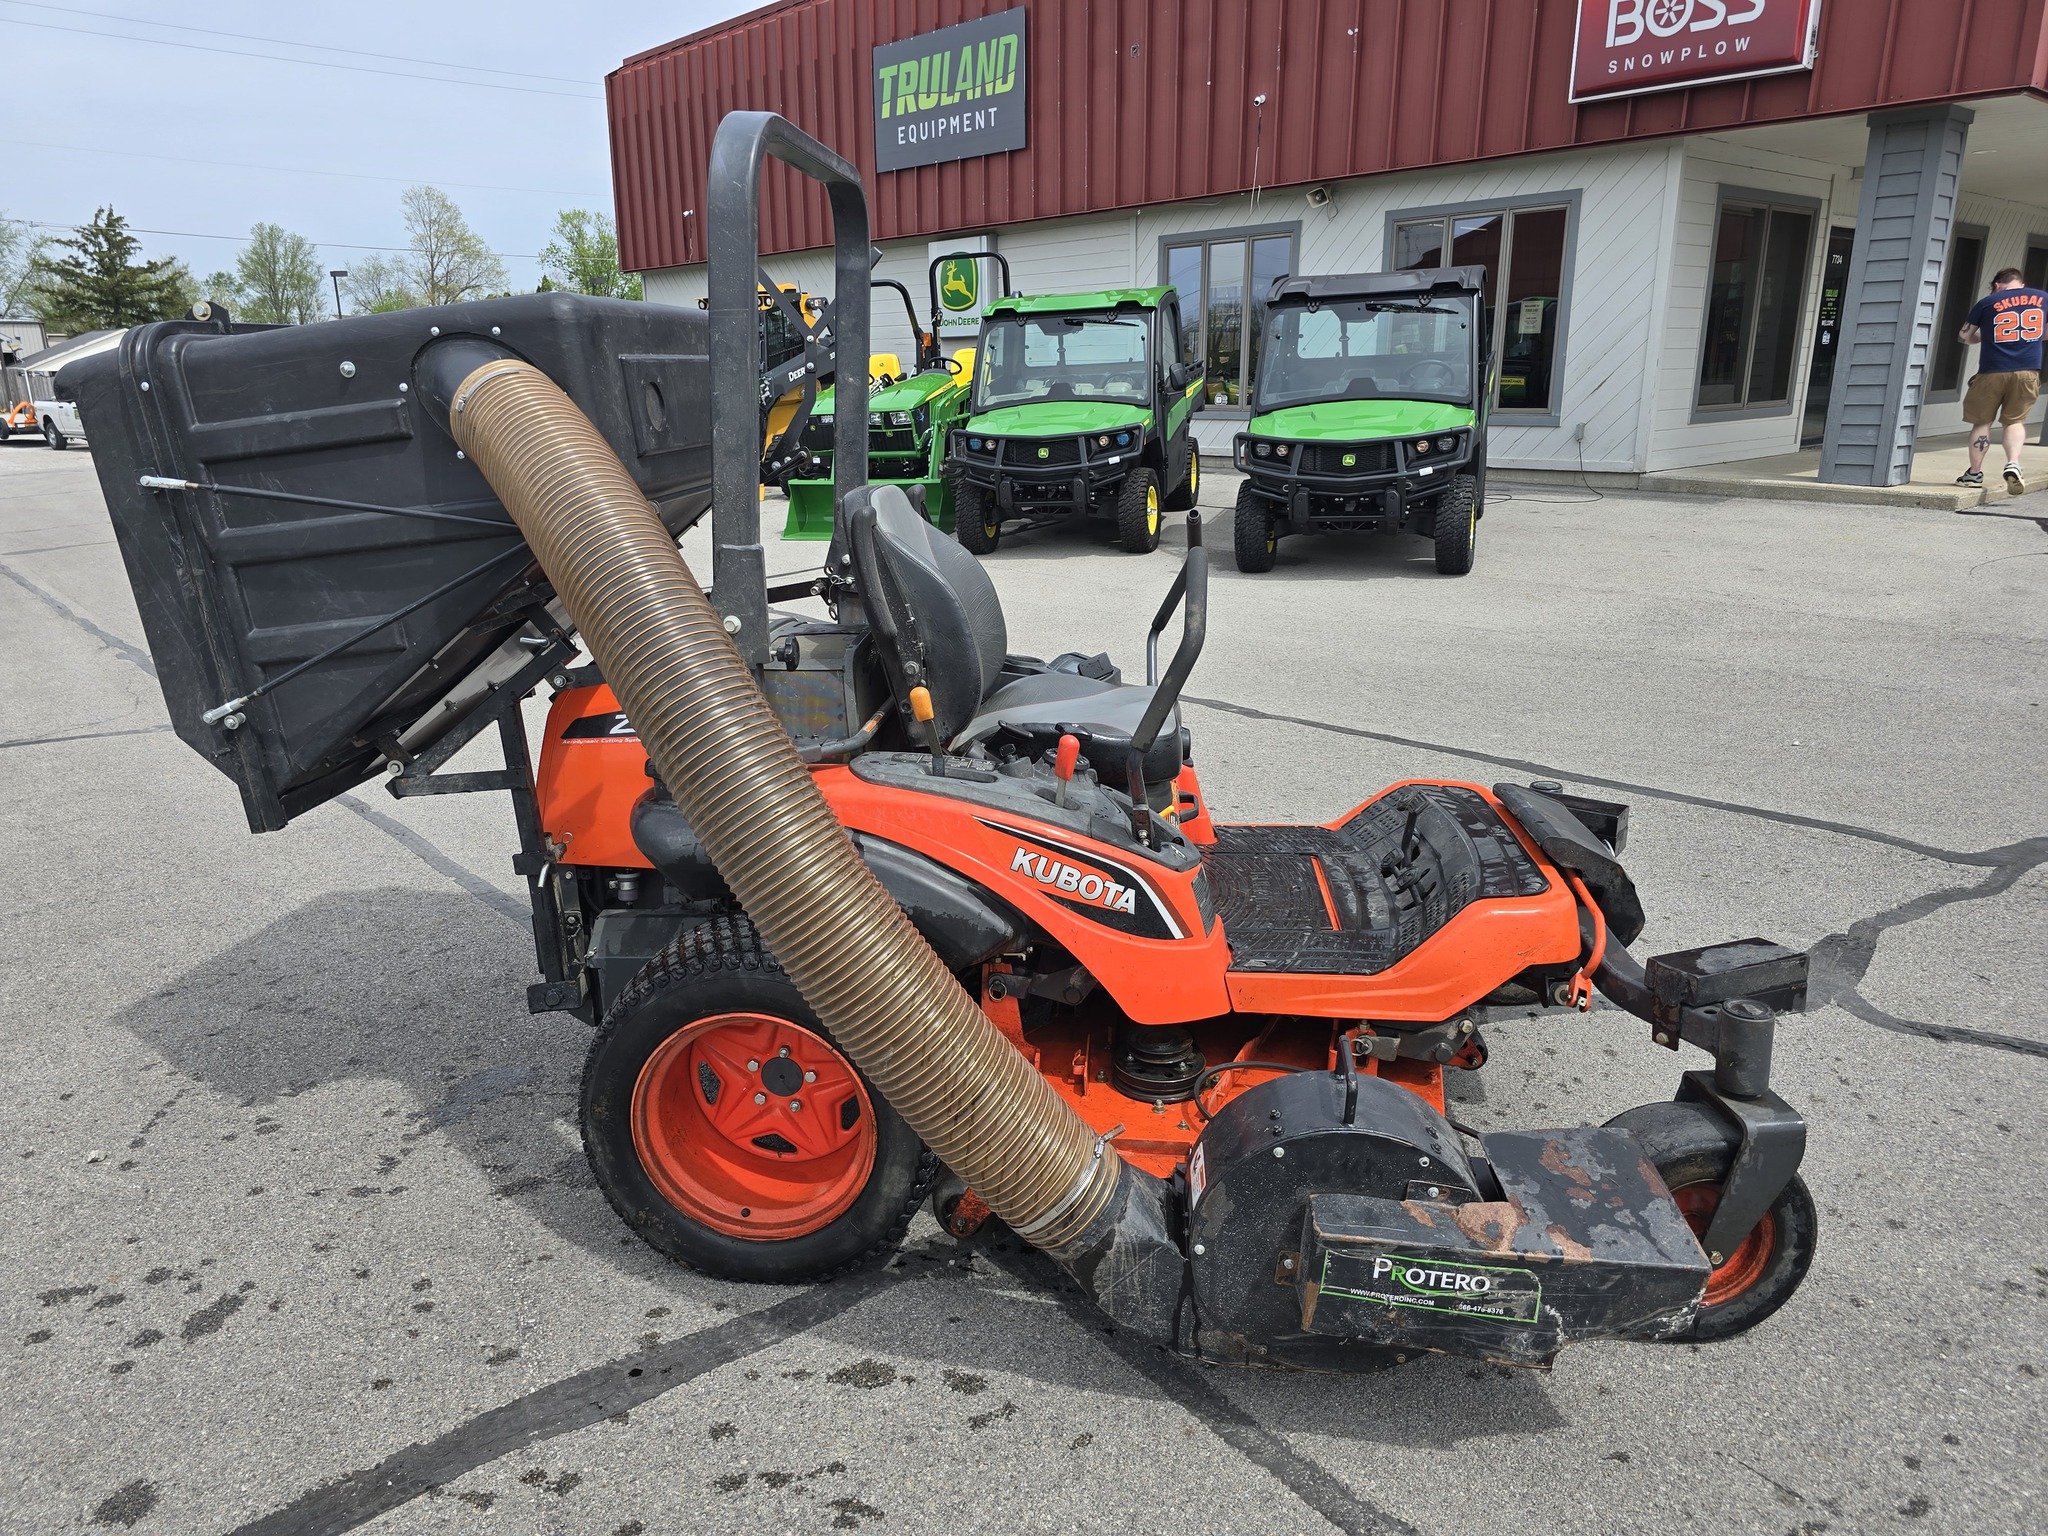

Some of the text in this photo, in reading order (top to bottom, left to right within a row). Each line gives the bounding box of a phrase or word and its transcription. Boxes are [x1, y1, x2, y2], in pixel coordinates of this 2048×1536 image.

[1608, 36, 1751, 74] SNOWPLOW
[879, 34, 1018, 119] TRULAND
[898, 107, 998, 144] EQUIPMENT
[939, 316, 979, 327] JOHN DEERE
[1993, 295, 2043, 312] SKUBAL
[1993, 308, 2044, 343] 29
[788, 366, 806, 382] DEER
[609, 713, 636, 734] Z
[1010, 847, 1136, 915] KUBOTA
[1372, 1257, 1490, 1294] PROTERO
